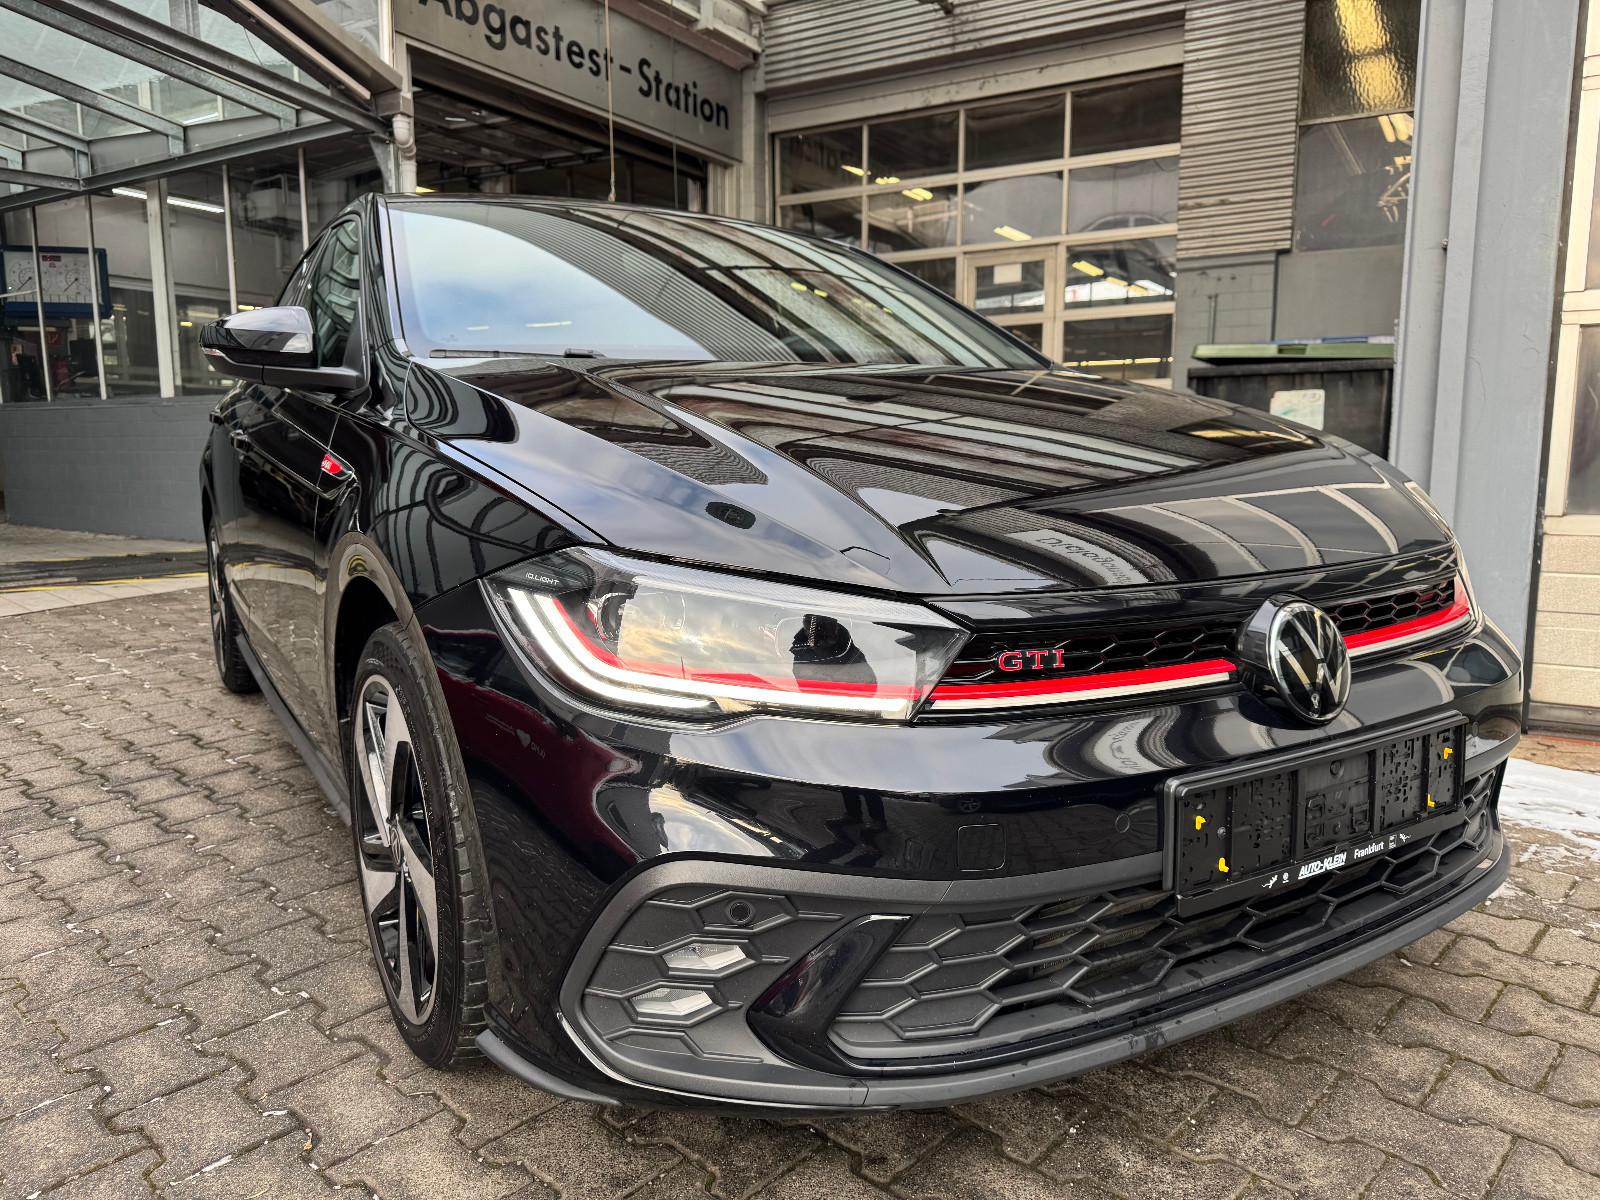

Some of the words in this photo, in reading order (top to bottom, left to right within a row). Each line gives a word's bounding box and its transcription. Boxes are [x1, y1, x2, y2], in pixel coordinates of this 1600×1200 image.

[525, 572, 560, 585] IQ.LIGHT
[998, 648, 1066, 672] GTI
[1298, 851, 1347, 878] AUTO-KLEIN
[1353, 841, 1385, 860] Frankfurt
